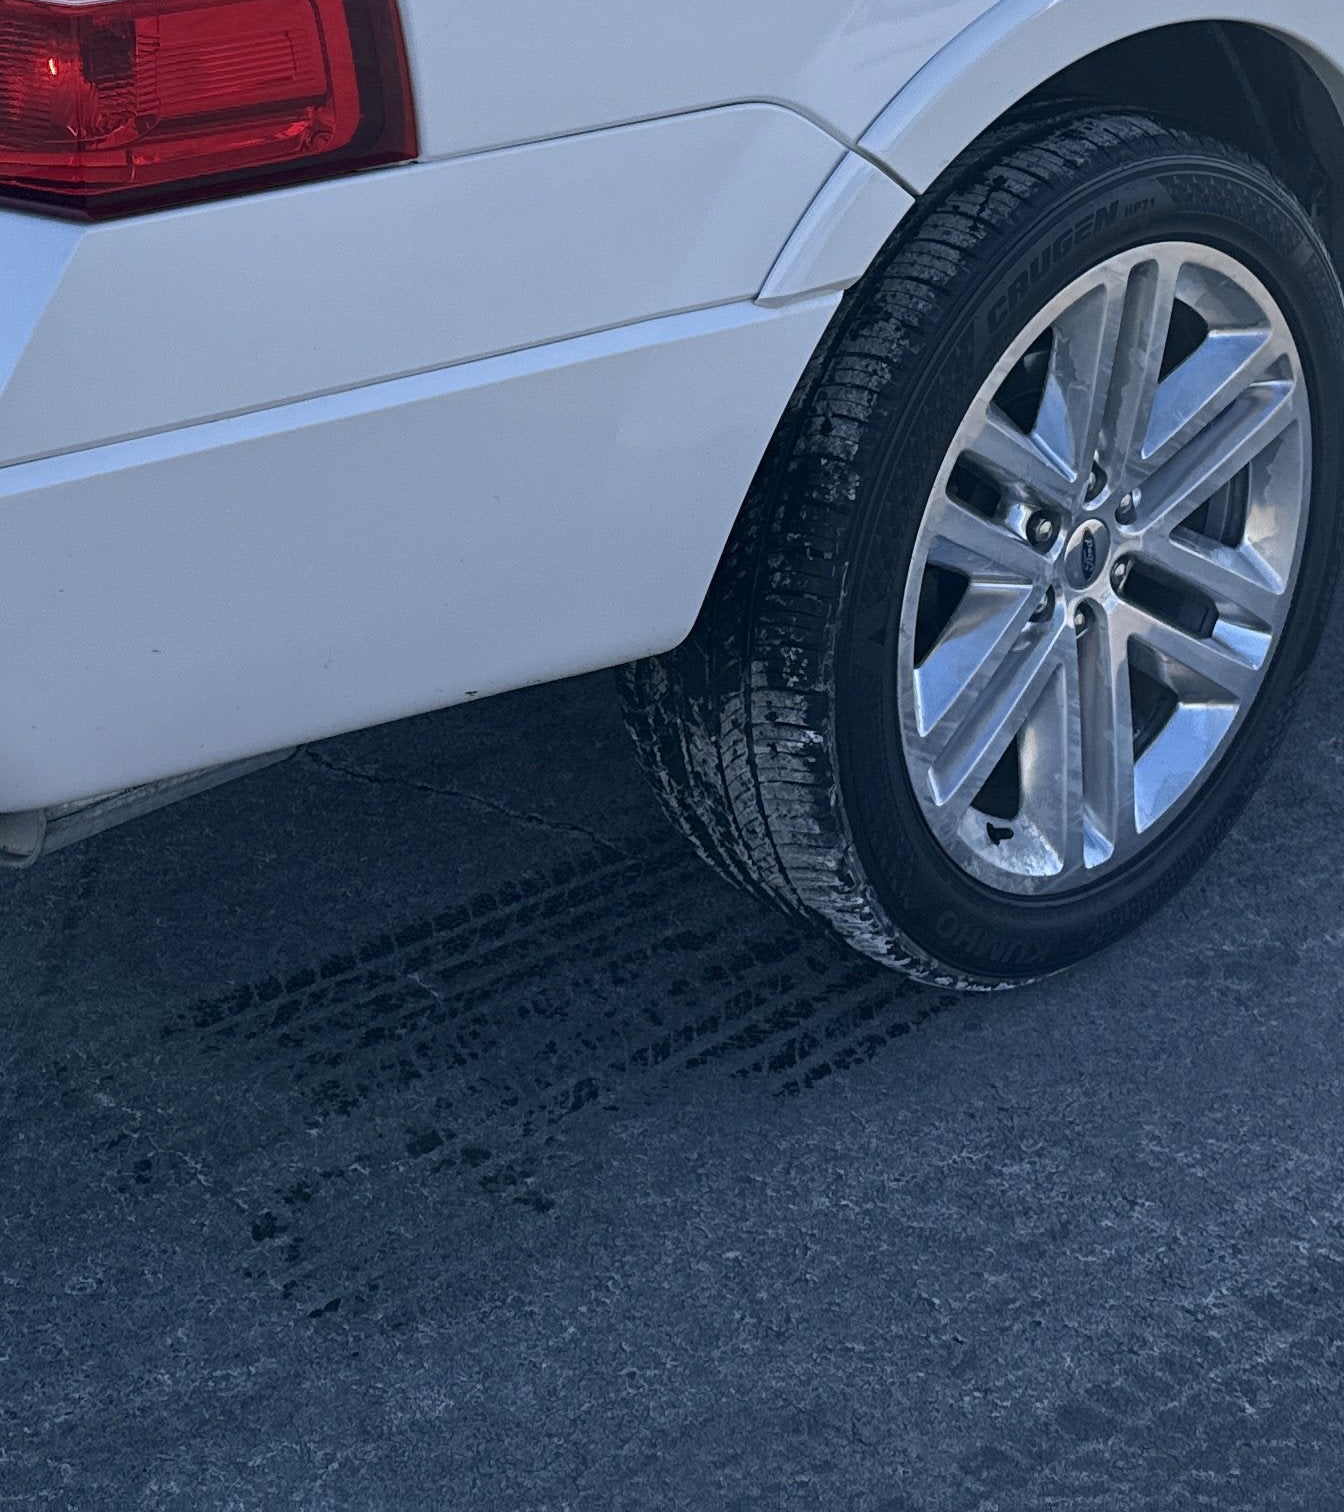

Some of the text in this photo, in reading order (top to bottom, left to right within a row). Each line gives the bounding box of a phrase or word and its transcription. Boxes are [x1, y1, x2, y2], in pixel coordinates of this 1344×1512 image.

[986, 196, 1156, 334] CRUGEN HP71
[1083, 538, 1096, 572] Ford
